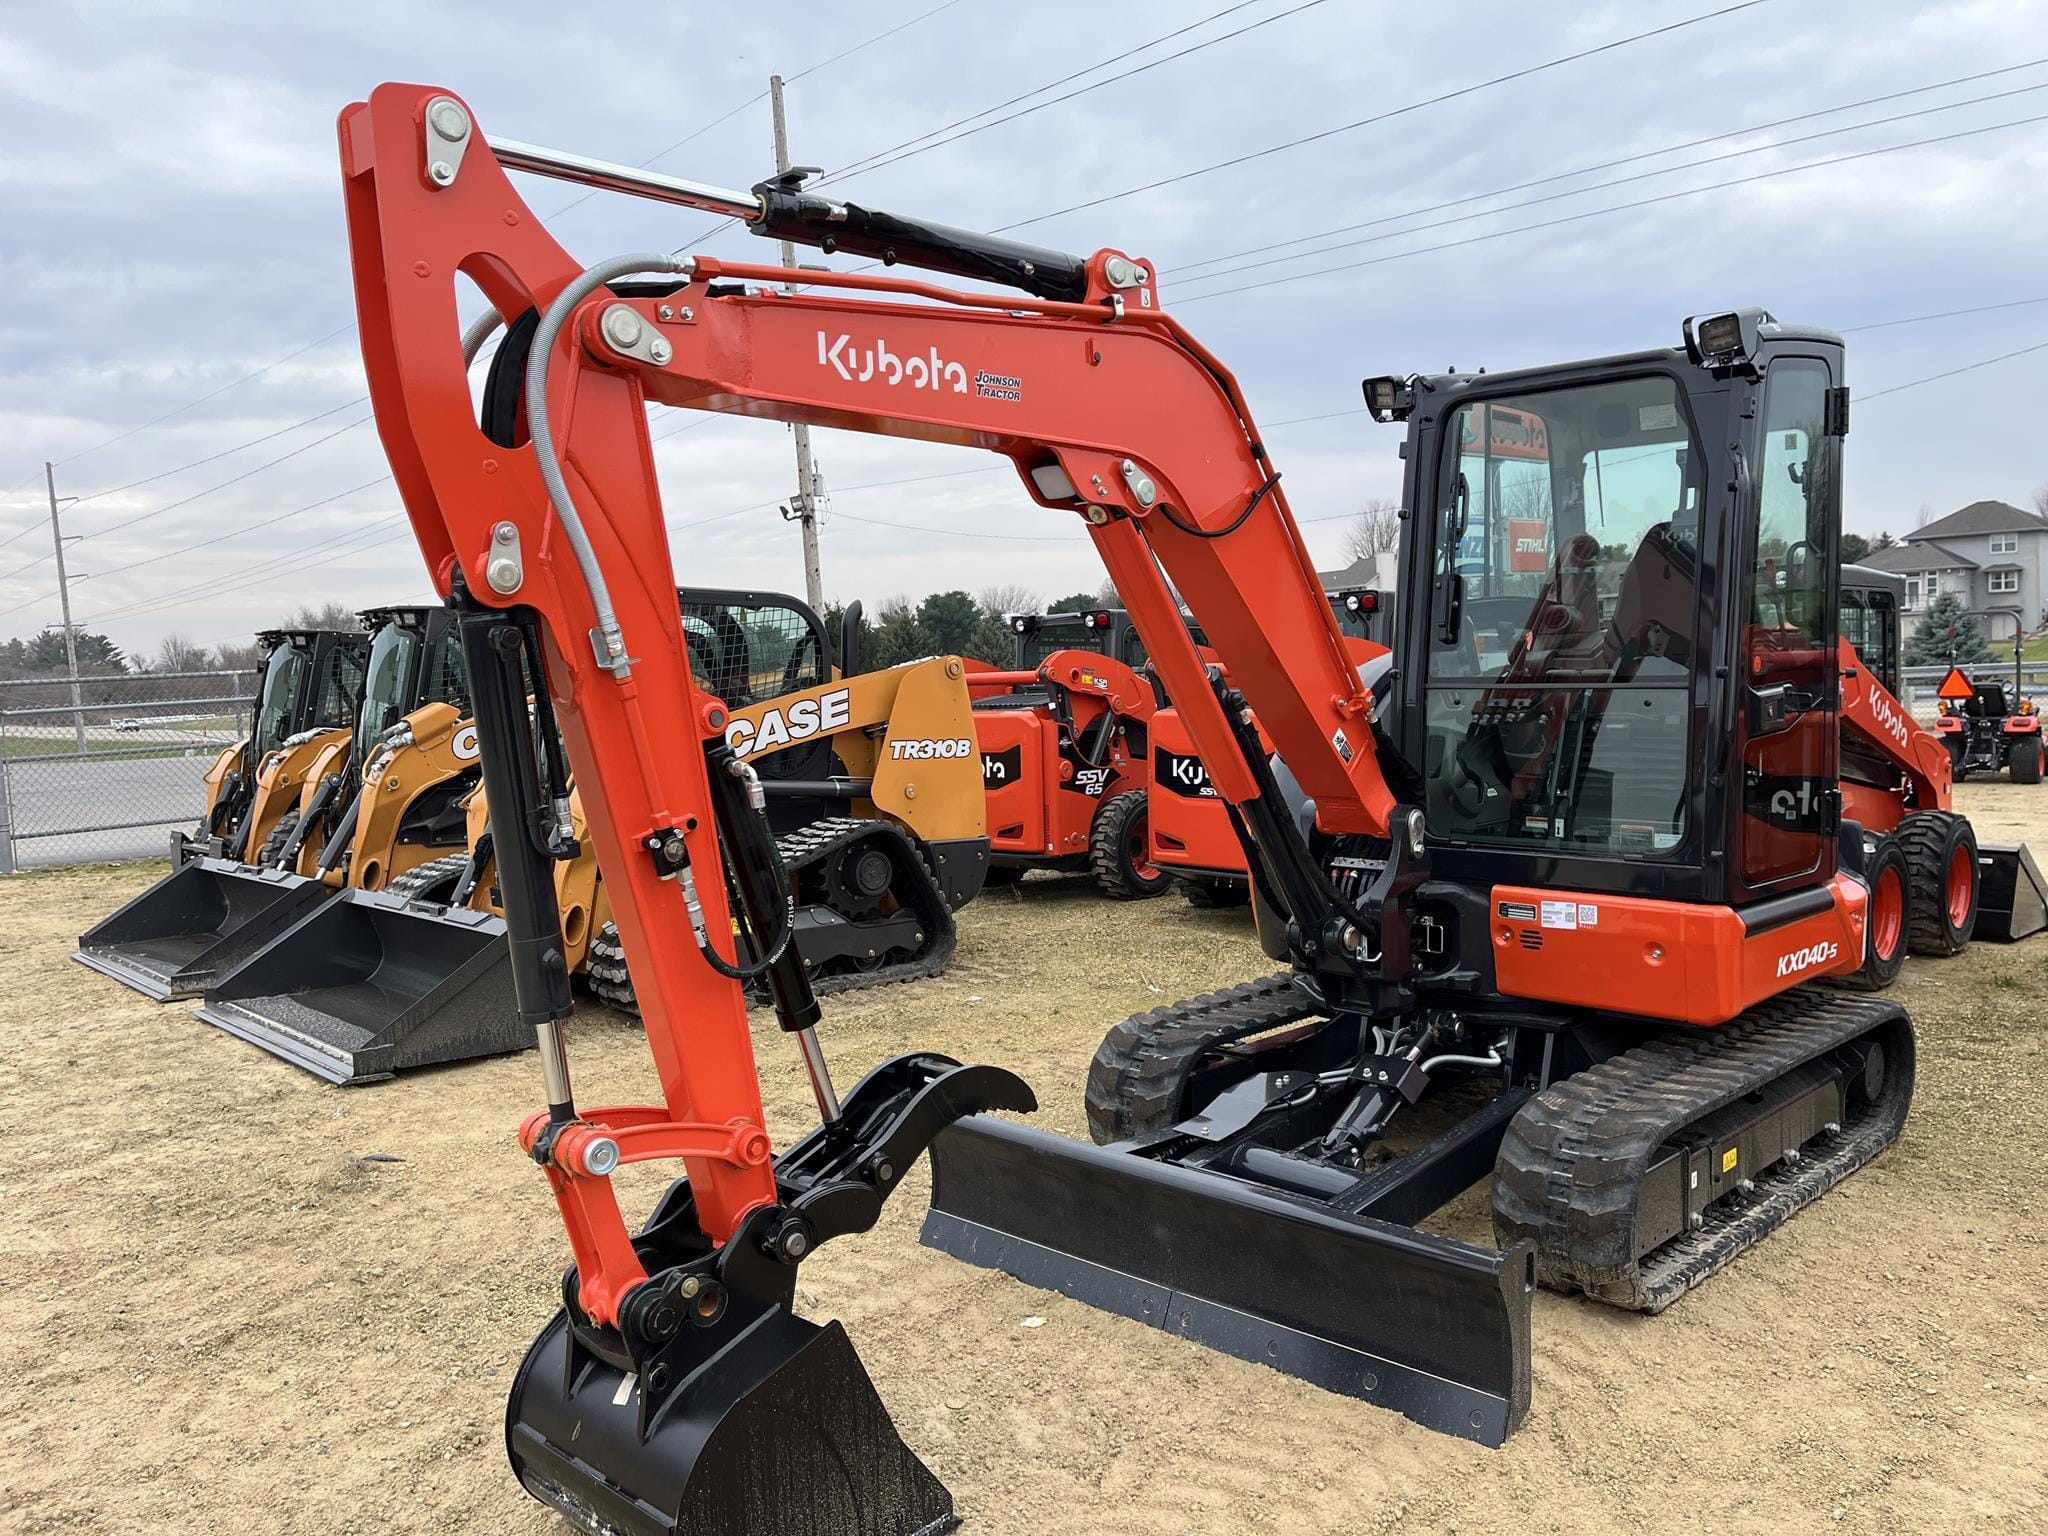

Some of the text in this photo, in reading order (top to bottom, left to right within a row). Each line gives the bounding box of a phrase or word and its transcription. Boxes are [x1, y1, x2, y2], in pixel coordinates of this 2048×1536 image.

[817, 330, 968, 394] Kubota
[974, 369, 1021, 388] JOHNSON
[976, 383, 1021, 401] TRACTOR
[1515, 538, 1546, 552] STIHL
[725, 688, 850, 758] CASE
[1869, 684, 1908, 748] Kubota
[890, 739, 971, 760] TR310B
[1075, 768, 1110, 784] SSV
[1085, 783, 1104, 795] 65
[1776, 941, 1839, 978] KX040-5
